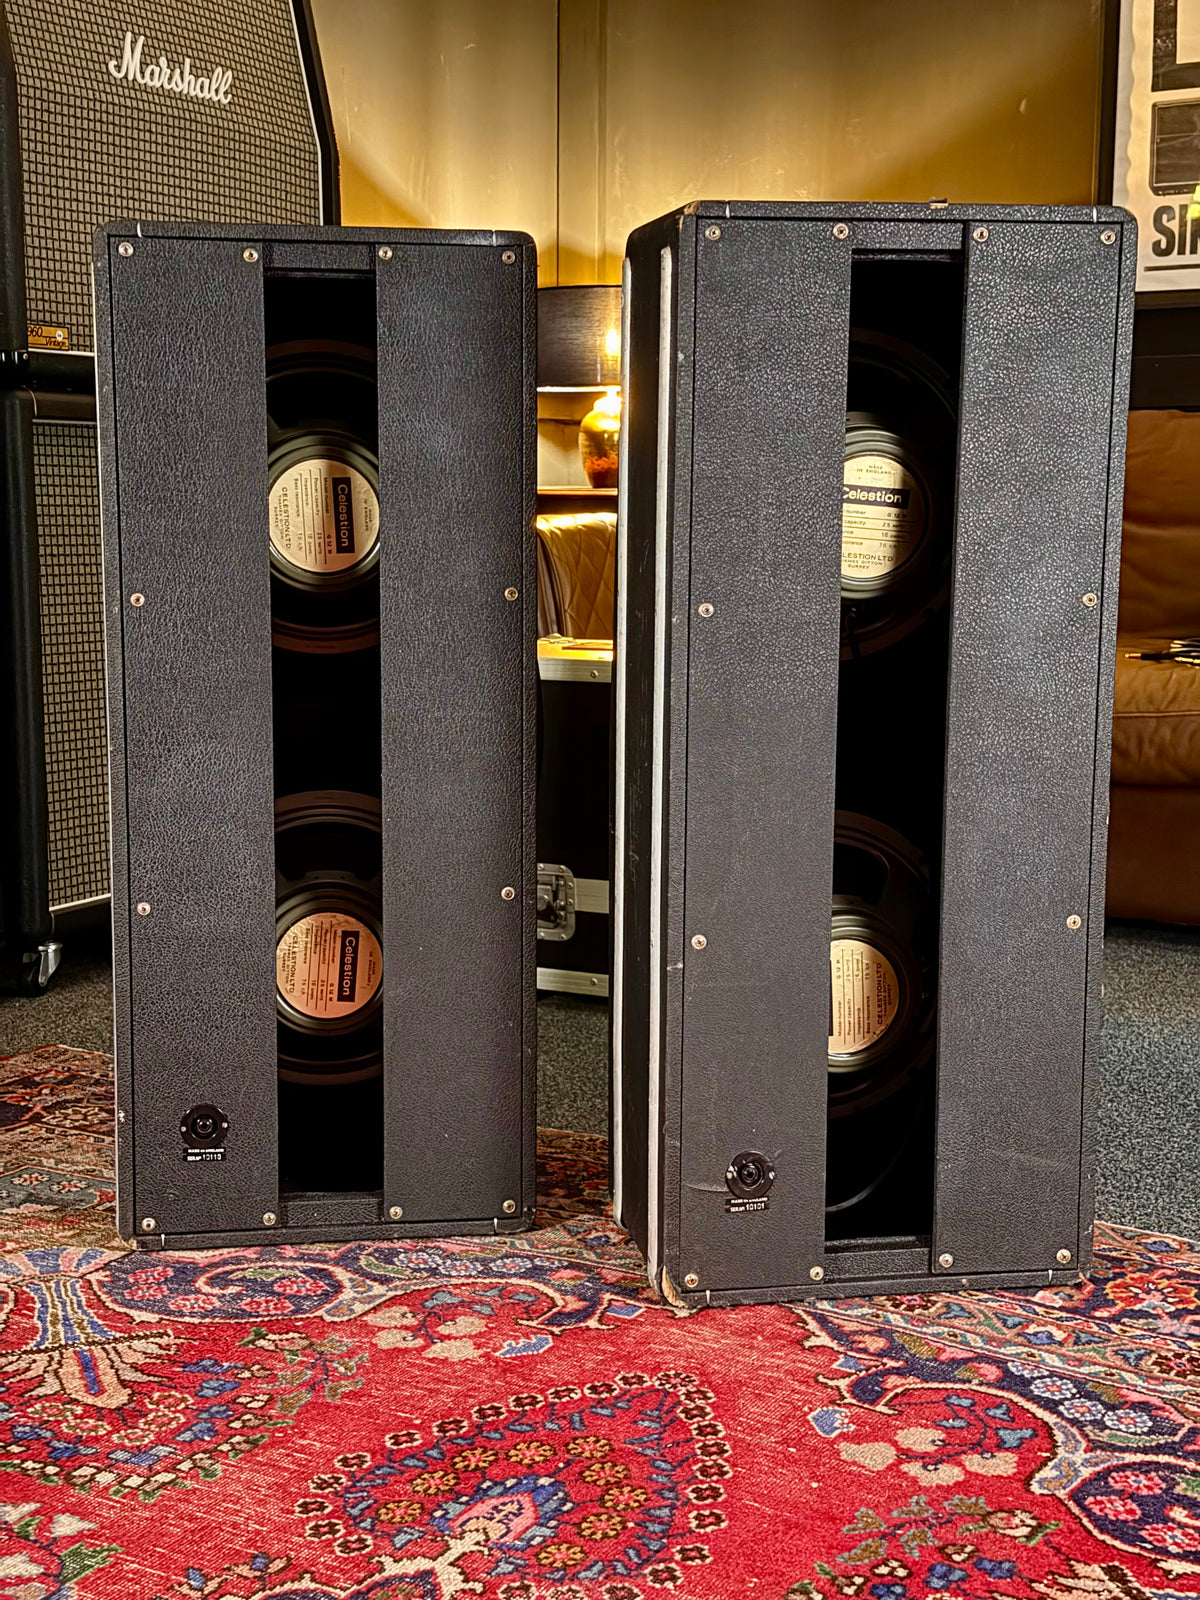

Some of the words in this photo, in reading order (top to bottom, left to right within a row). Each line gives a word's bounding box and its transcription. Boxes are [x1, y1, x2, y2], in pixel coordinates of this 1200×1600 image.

[108, 31, 233, 105] Marshall
[281, 487, 290, 531] CELESTION
[338, 484, 350, 546] Celestion
[290, 936, 298, 977] CELESTION
[342, 937, 356, 996] Celestion
[746, 1202, 765, 1210] 10101
